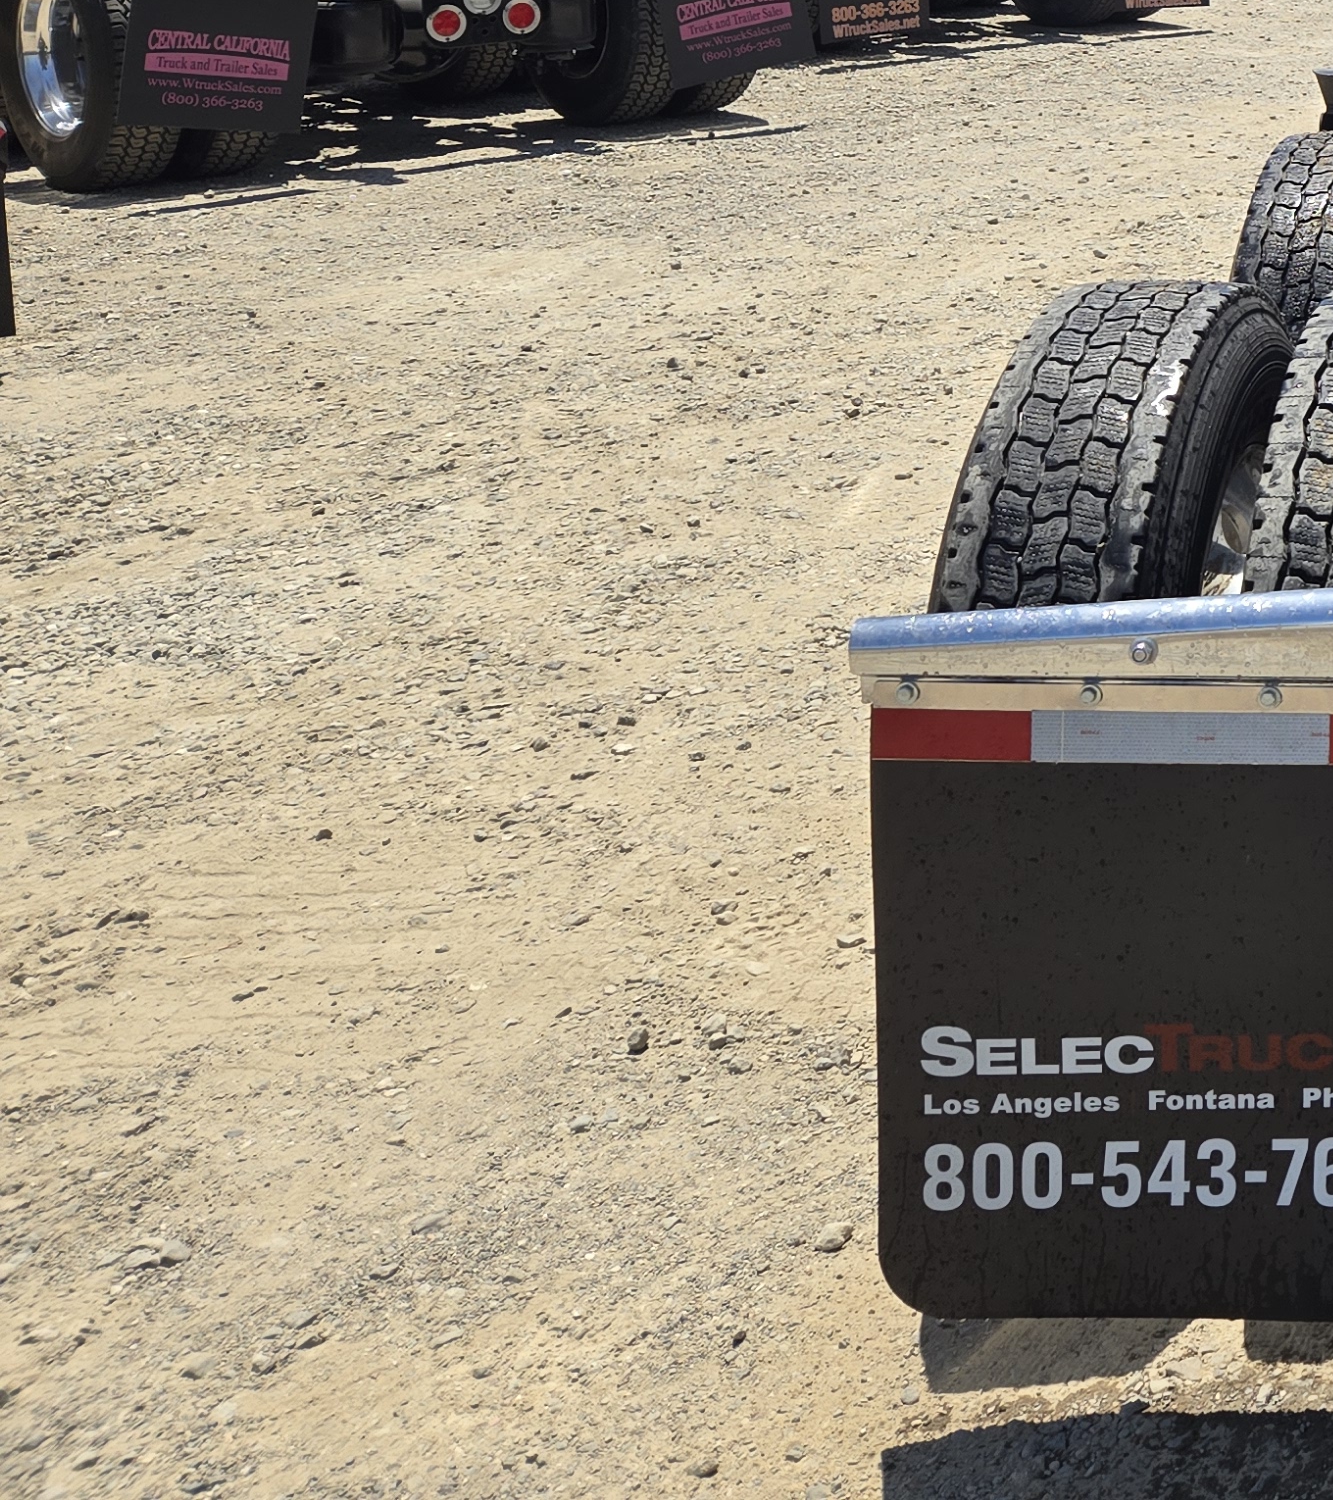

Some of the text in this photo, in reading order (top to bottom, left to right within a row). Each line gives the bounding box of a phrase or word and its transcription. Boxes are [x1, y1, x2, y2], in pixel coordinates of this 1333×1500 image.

[688, 7, 783, 35] Truck and Trailer Sales
[833, 15, 920, 38] WTruckSales.net
[148, 29, 290, 61] CENTRAL CALIFORNIA
[686, 22, 791, 51] www.WtruckSales.com
[702, 38, 782, 63] (800) 366-3263
[156, 57, 277, 76] Truck and Trailer Sales
[148, 77, 282, 95] www.WtruckSales.com
[161, 91, 264, 111] (800) 366-3263
[923, 1094, 980, 1115] Los
[990, 1091, 1120, 1119] Angeles
[1148, 1089, 1275, 1110] Fontana
